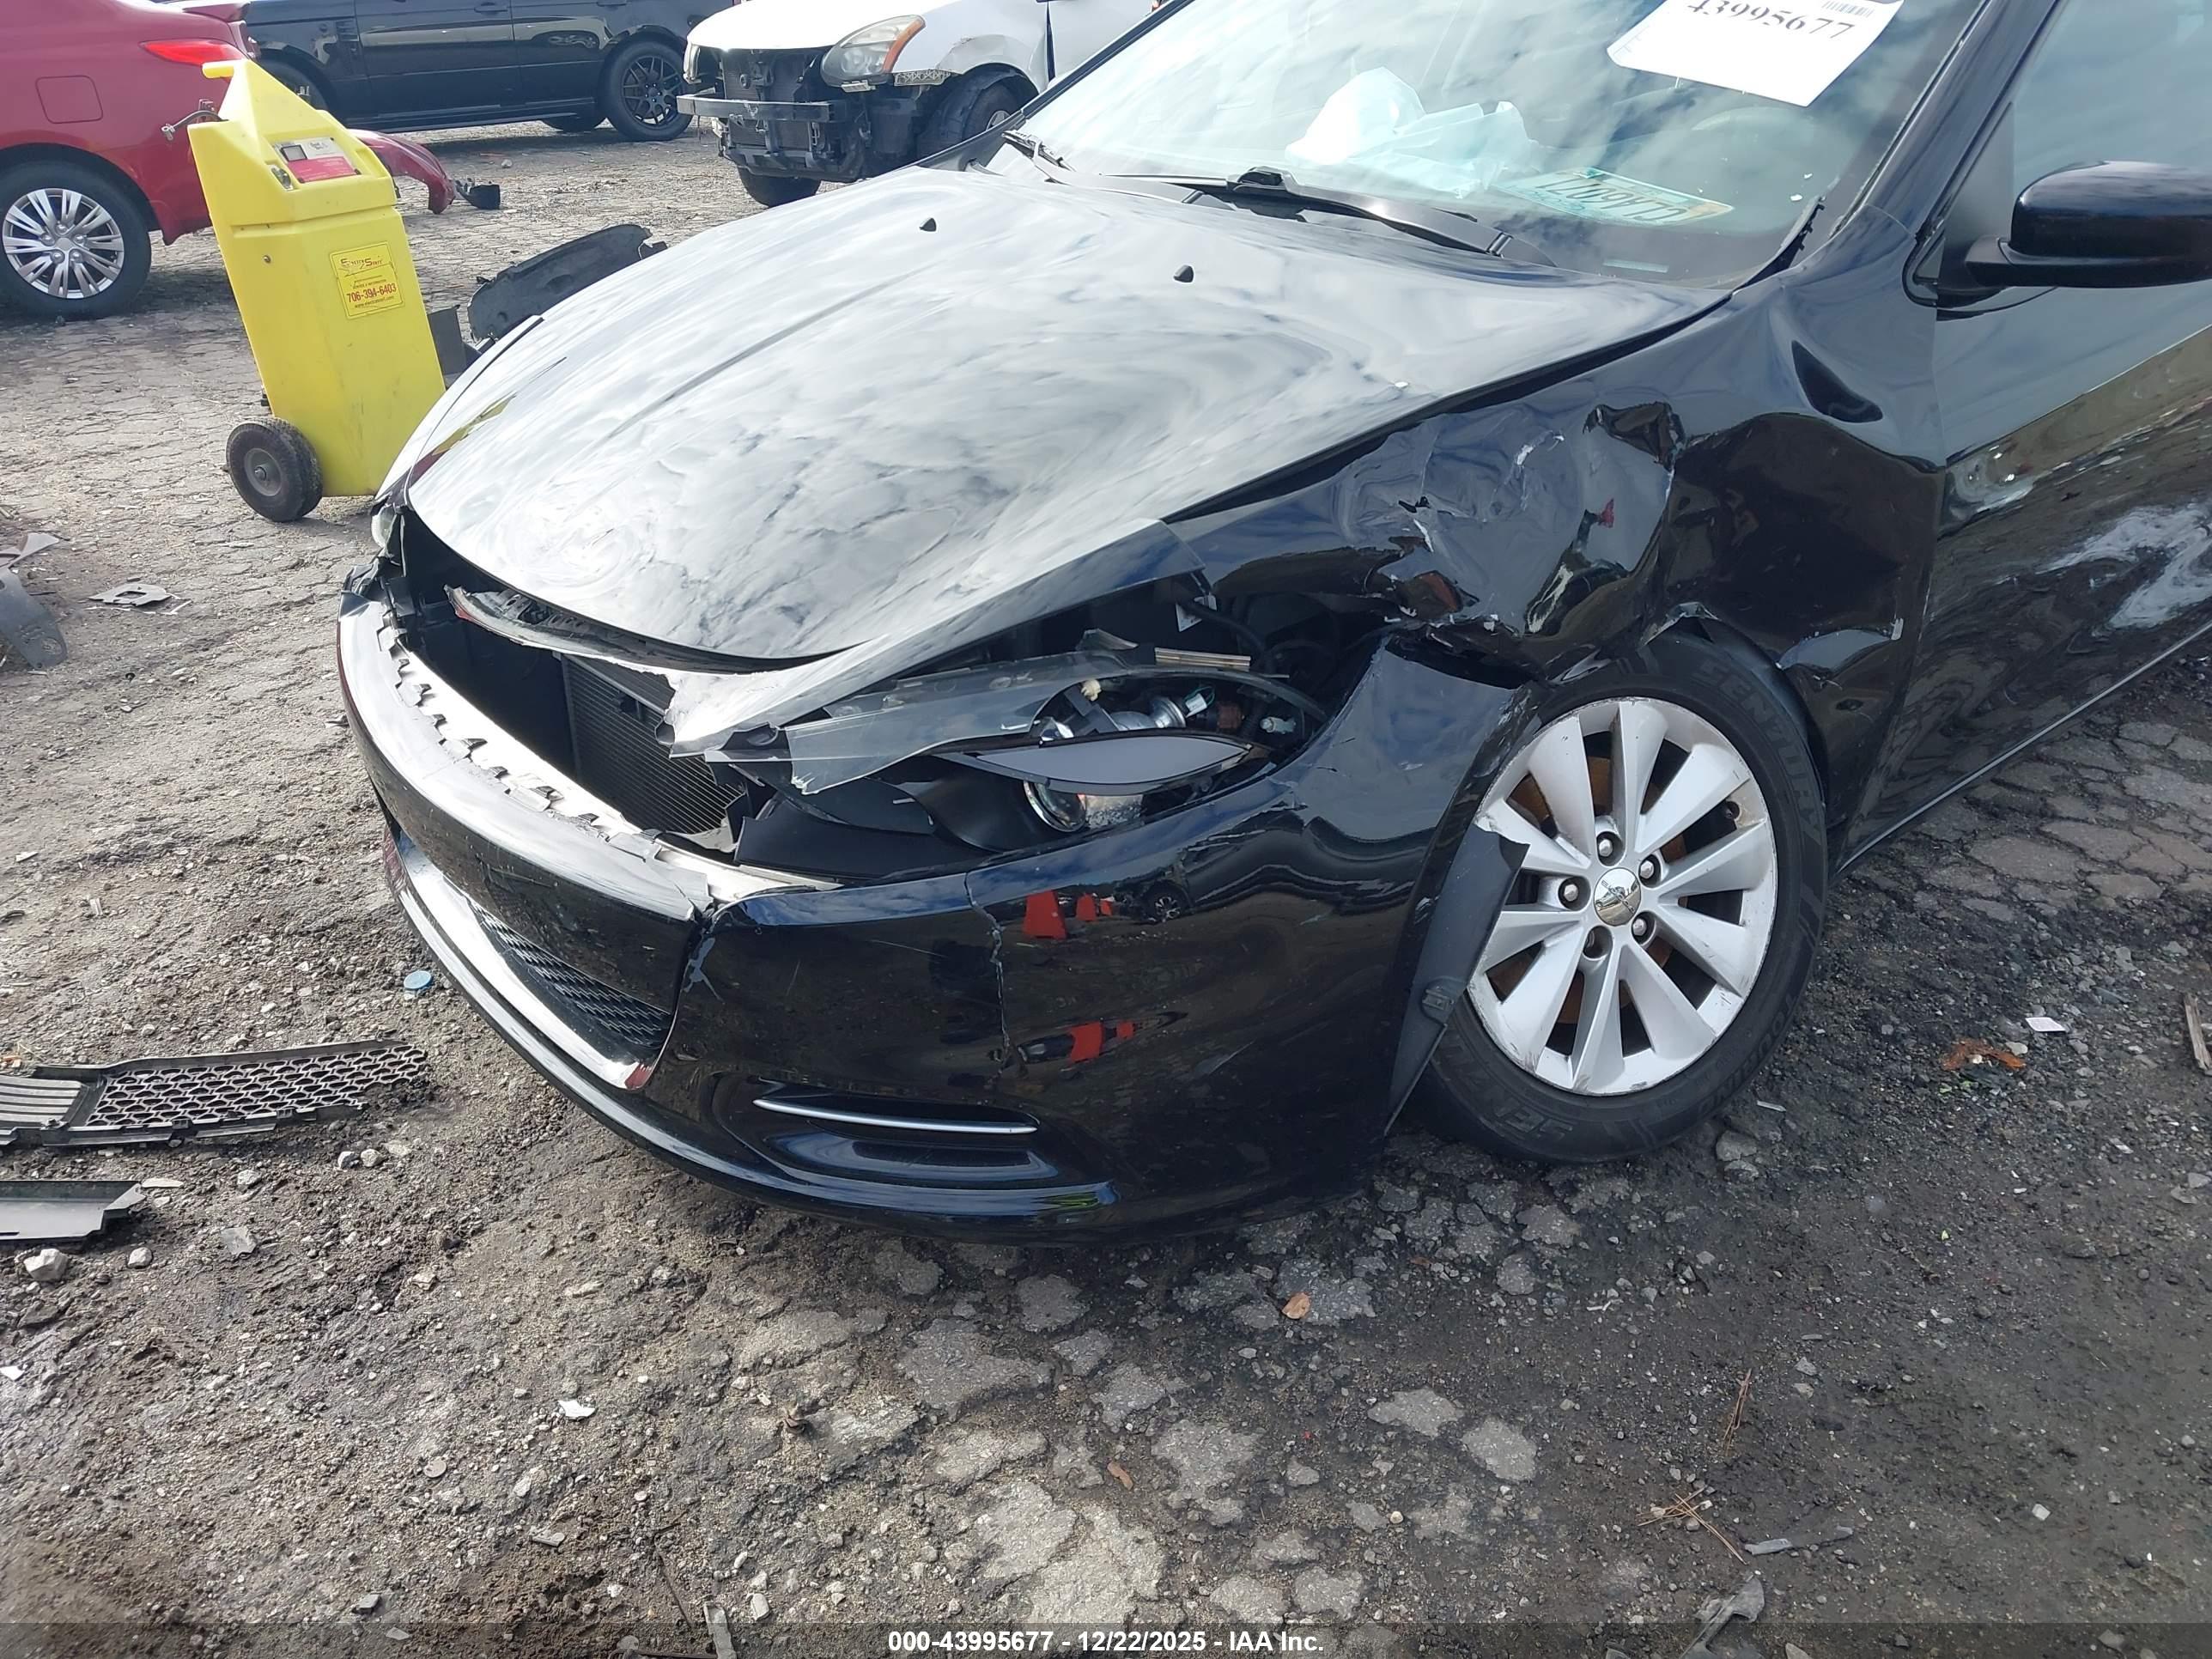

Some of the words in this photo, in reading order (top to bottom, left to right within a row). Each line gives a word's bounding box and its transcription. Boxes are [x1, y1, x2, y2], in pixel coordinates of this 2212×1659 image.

[1686, 0, 1856, 39] 43995677
[1534, 177, 1689, 222] CLA6071
[346, 283, 397, 302] 706-394-6403
[1691, 654, 1823, 847] SENTURY
